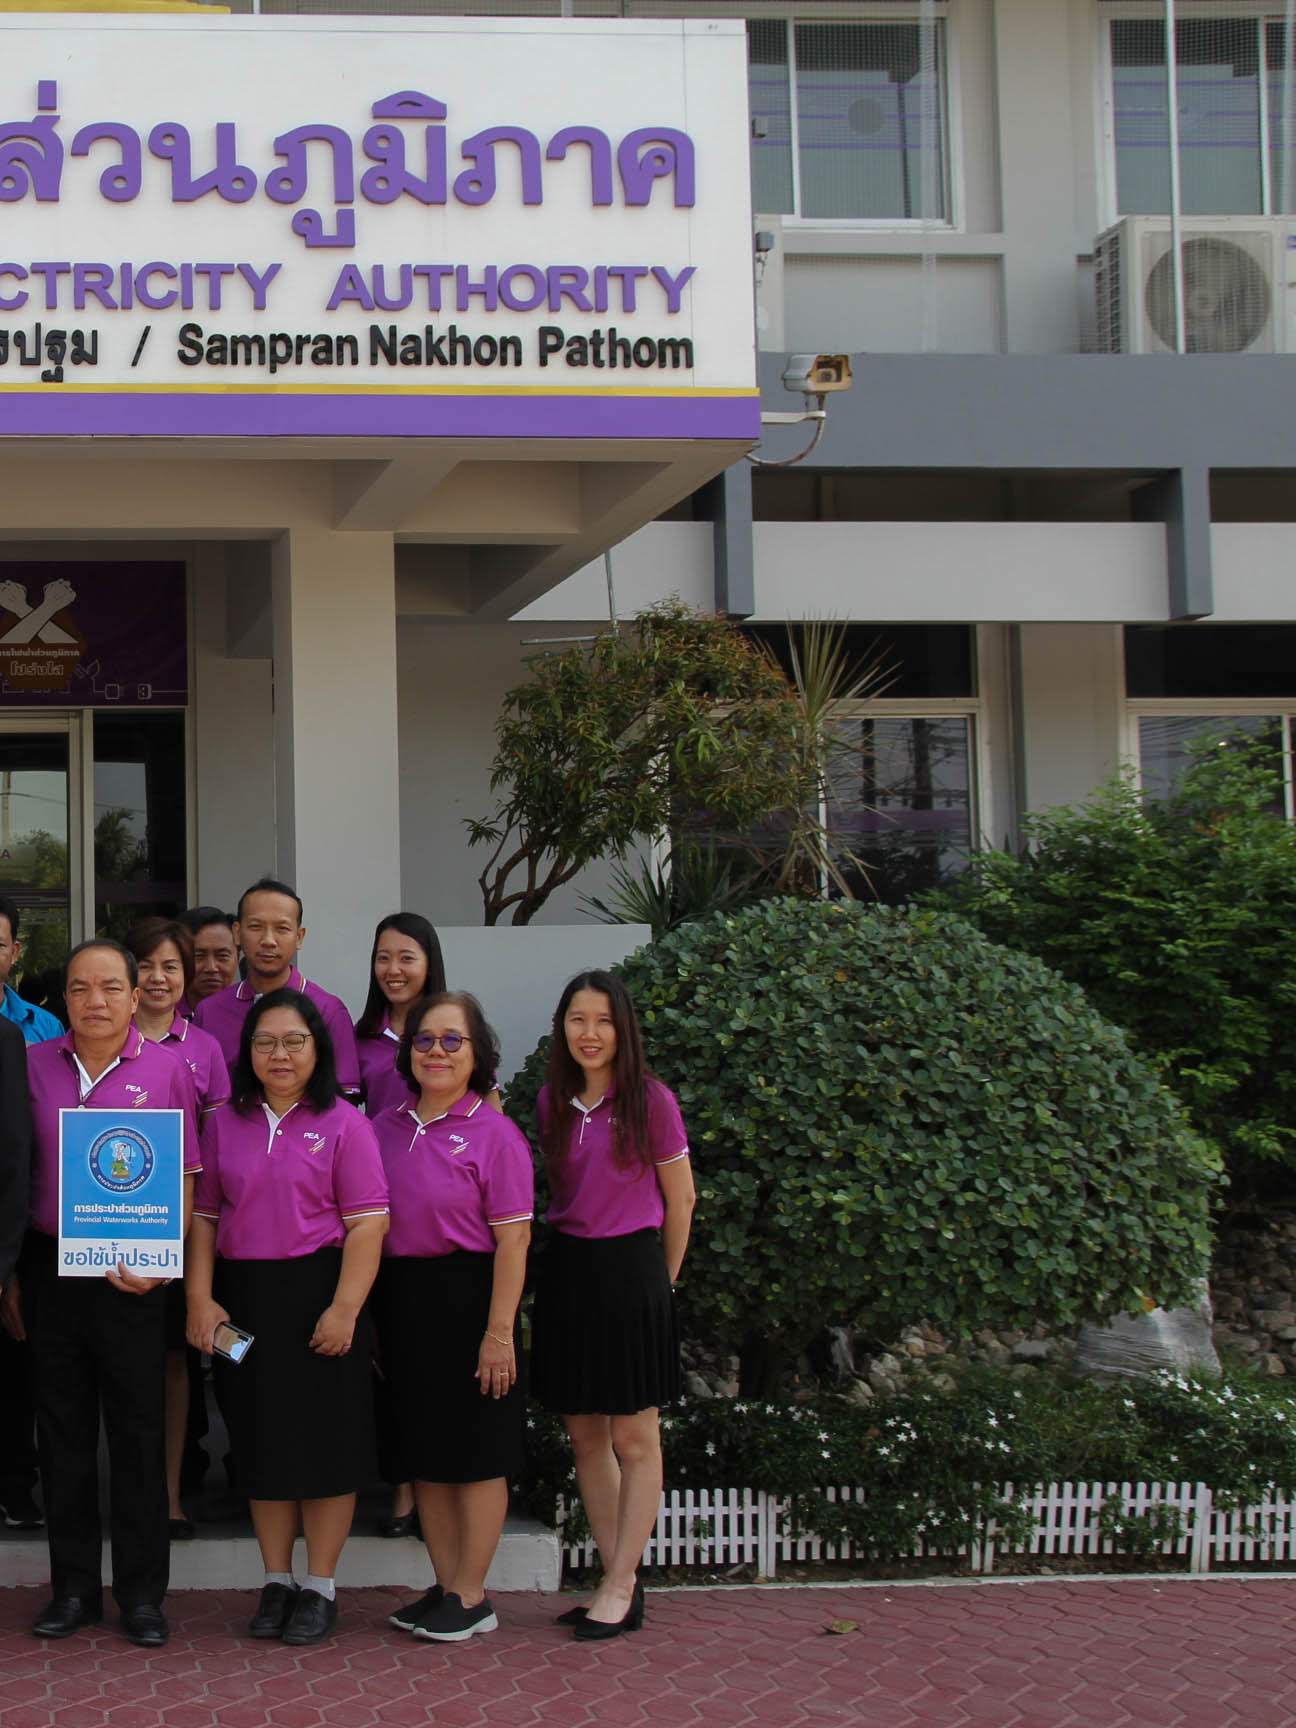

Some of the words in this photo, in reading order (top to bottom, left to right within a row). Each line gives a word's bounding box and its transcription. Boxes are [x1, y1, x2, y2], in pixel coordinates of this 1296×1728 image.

[327, 263, 697, 312] AUTHORITY
[177, 323, 359, 374] Sampran
[369, 324, 523, 367] Nakhon
[538, 325, 694, 368] Pathom
[125, 1084, 142, 1093] PEA
[303, 1132, 319, 1140] PEA
[74, 1203, 169, 1216] การประปาส่วนภูมิภาค
[64, 1241, 178, 1267] ขอใช้น้ำประปา
